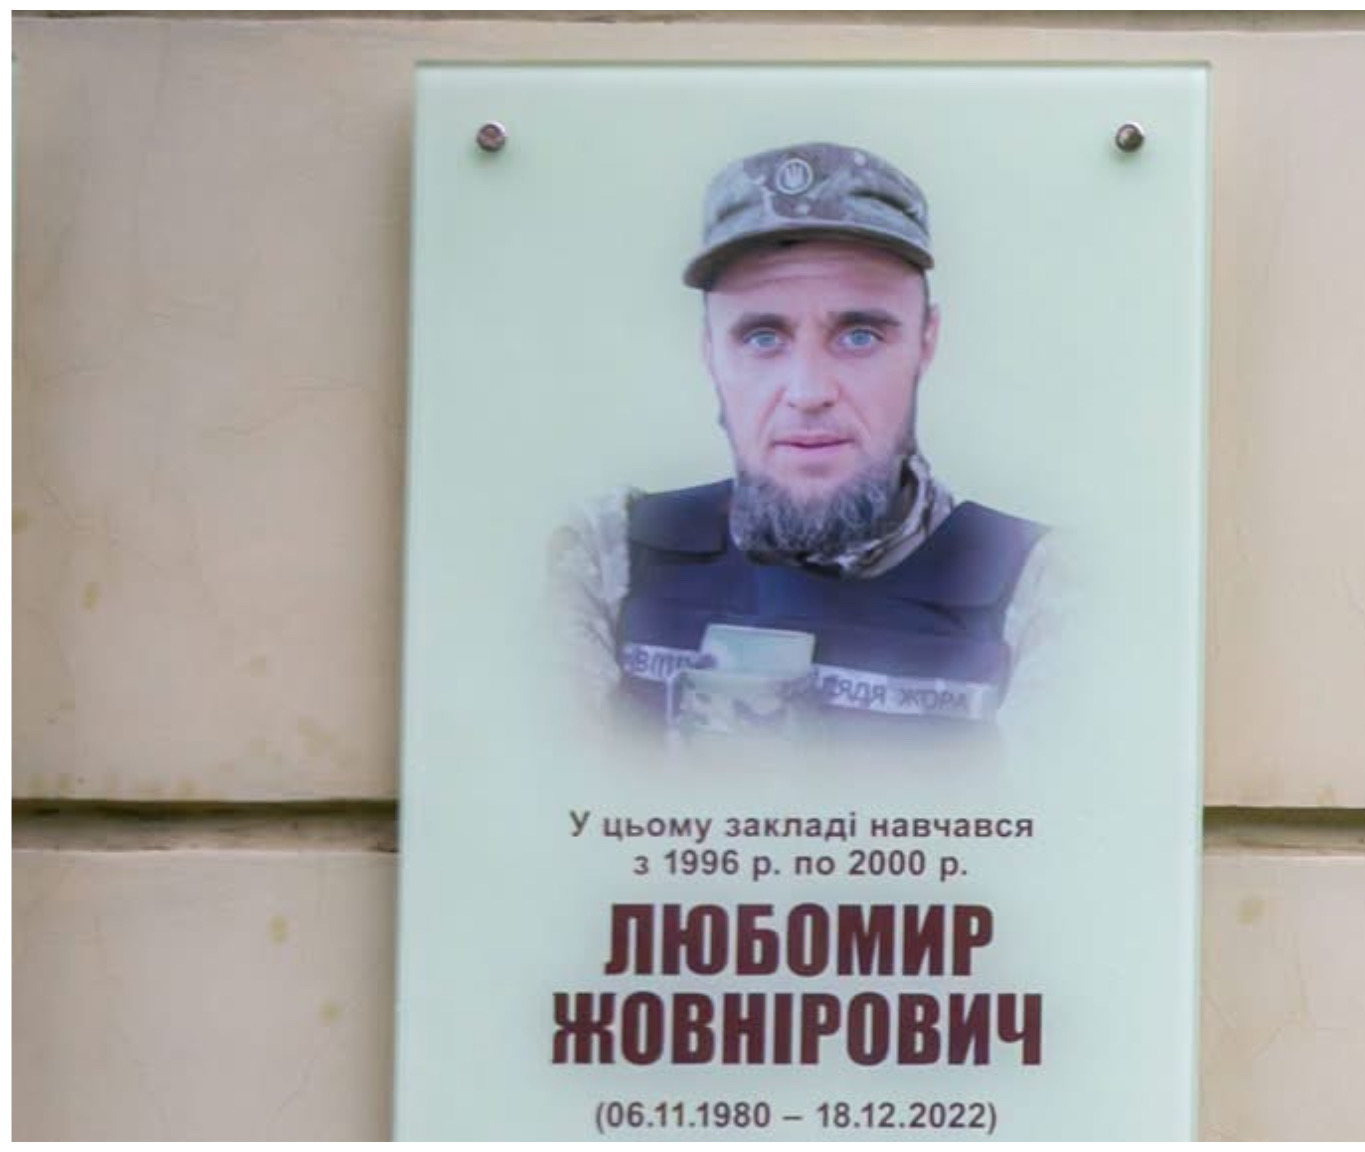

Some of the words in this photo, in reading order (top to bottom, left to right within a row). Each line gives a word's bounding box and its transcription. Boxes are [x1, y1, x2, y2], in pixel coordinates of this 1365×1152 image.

[569, 810, 591, 838] У
[603, 817, 713, 845] цьому
[724, 811, 856, 842] закладі
[870, 817, 1033, 838] навчався
[633, 855, 650, 876] з
[664, 848, 740, 876] 1996
[752, 855, 781, 883] р.
[794, 855, 836, 876] по
[847, 849, 926, 876] 2000
[939, 855, 968, 883] р.
[603, 902, 993, 978] ЛЮБОМИР
[551, 990, 1043, 1067] ЖОВНІРОВИЧ
[595, 1100, 771, 1134] (06.11.1980
[816, 1101, 997, 1135] 18.12.2022)
